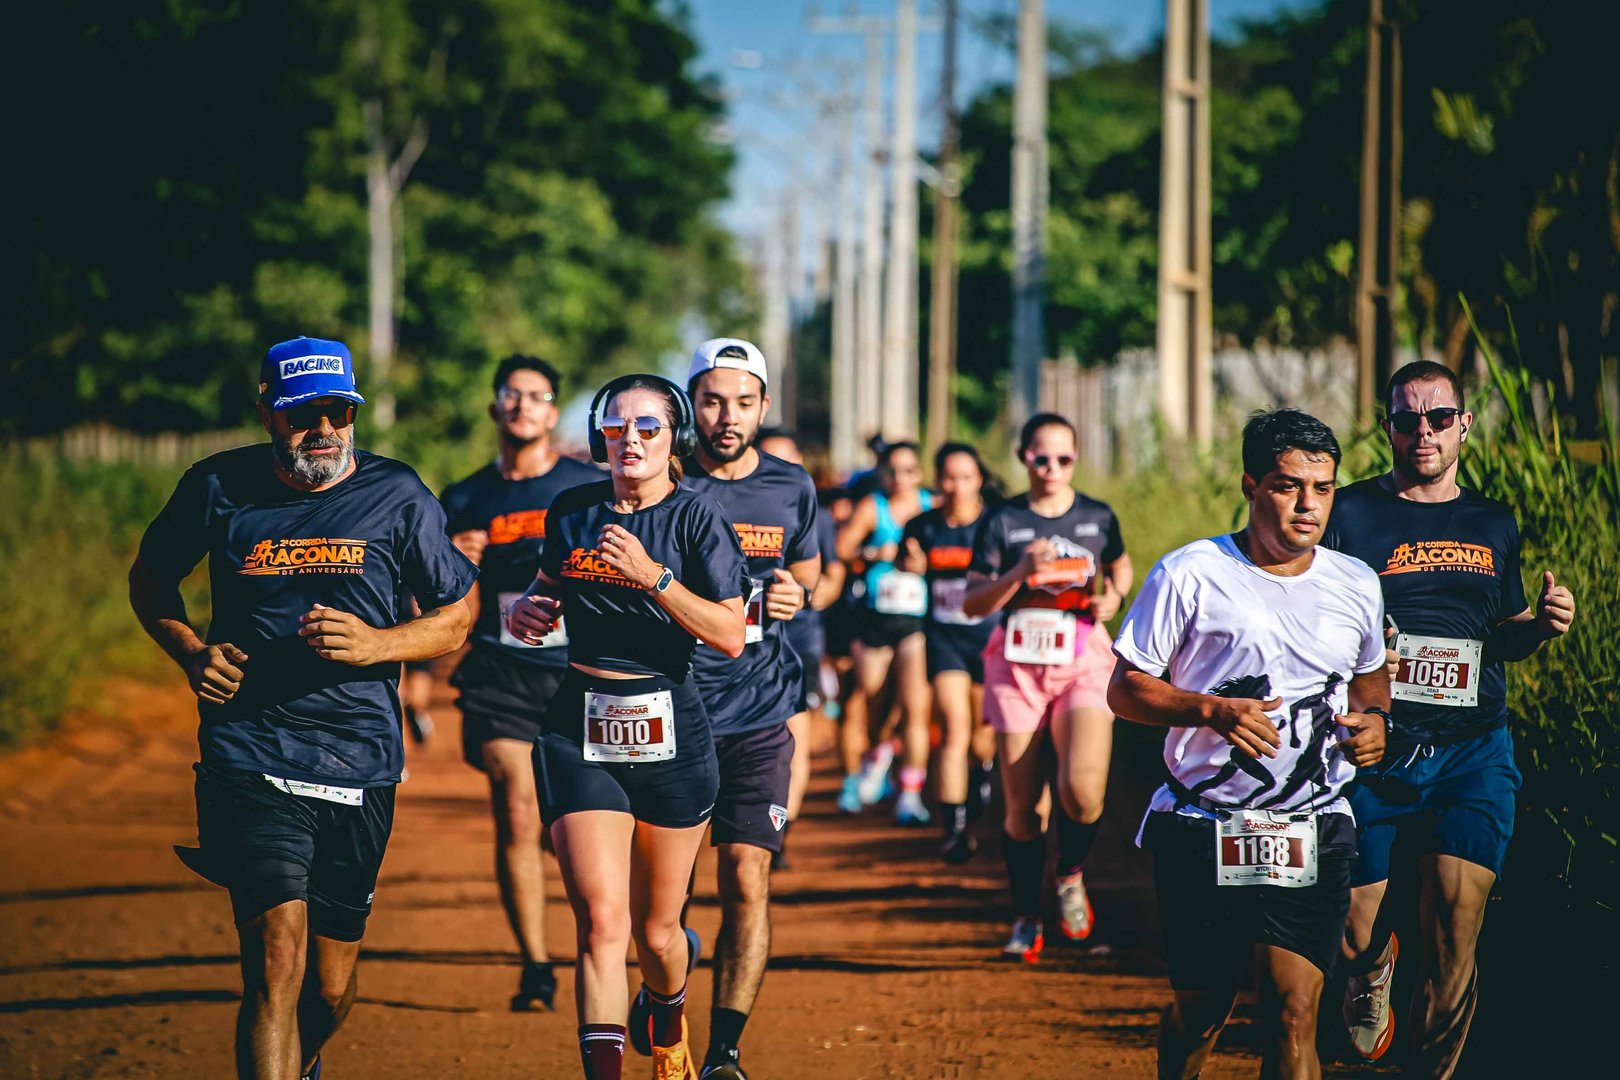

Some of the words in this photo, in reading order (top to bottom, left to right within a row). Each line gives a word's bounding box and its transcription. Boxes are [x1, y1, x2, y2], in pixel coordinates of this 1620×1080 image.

[284, 359, 340, 375] RACING
[289, 537, 328, 547] CORRIDA
[1425, 541, 1461, 549] CORRIDA
[274, 546, 364, 565] ACONAR
[1415, 548, 1494, 569] ACONAR
[298, 567, 364, 575] ANIVERSÁRIO
[584, 574, 595, 582] DE
[1428, 649, 1459, 658] ACONAR
[1406, 660, 1459, 688] 1056
[614, 707, 649, 716] ACONAR
[597, 719, 650, 745] 1010
[1233, 835, 1291, 867] 1188
